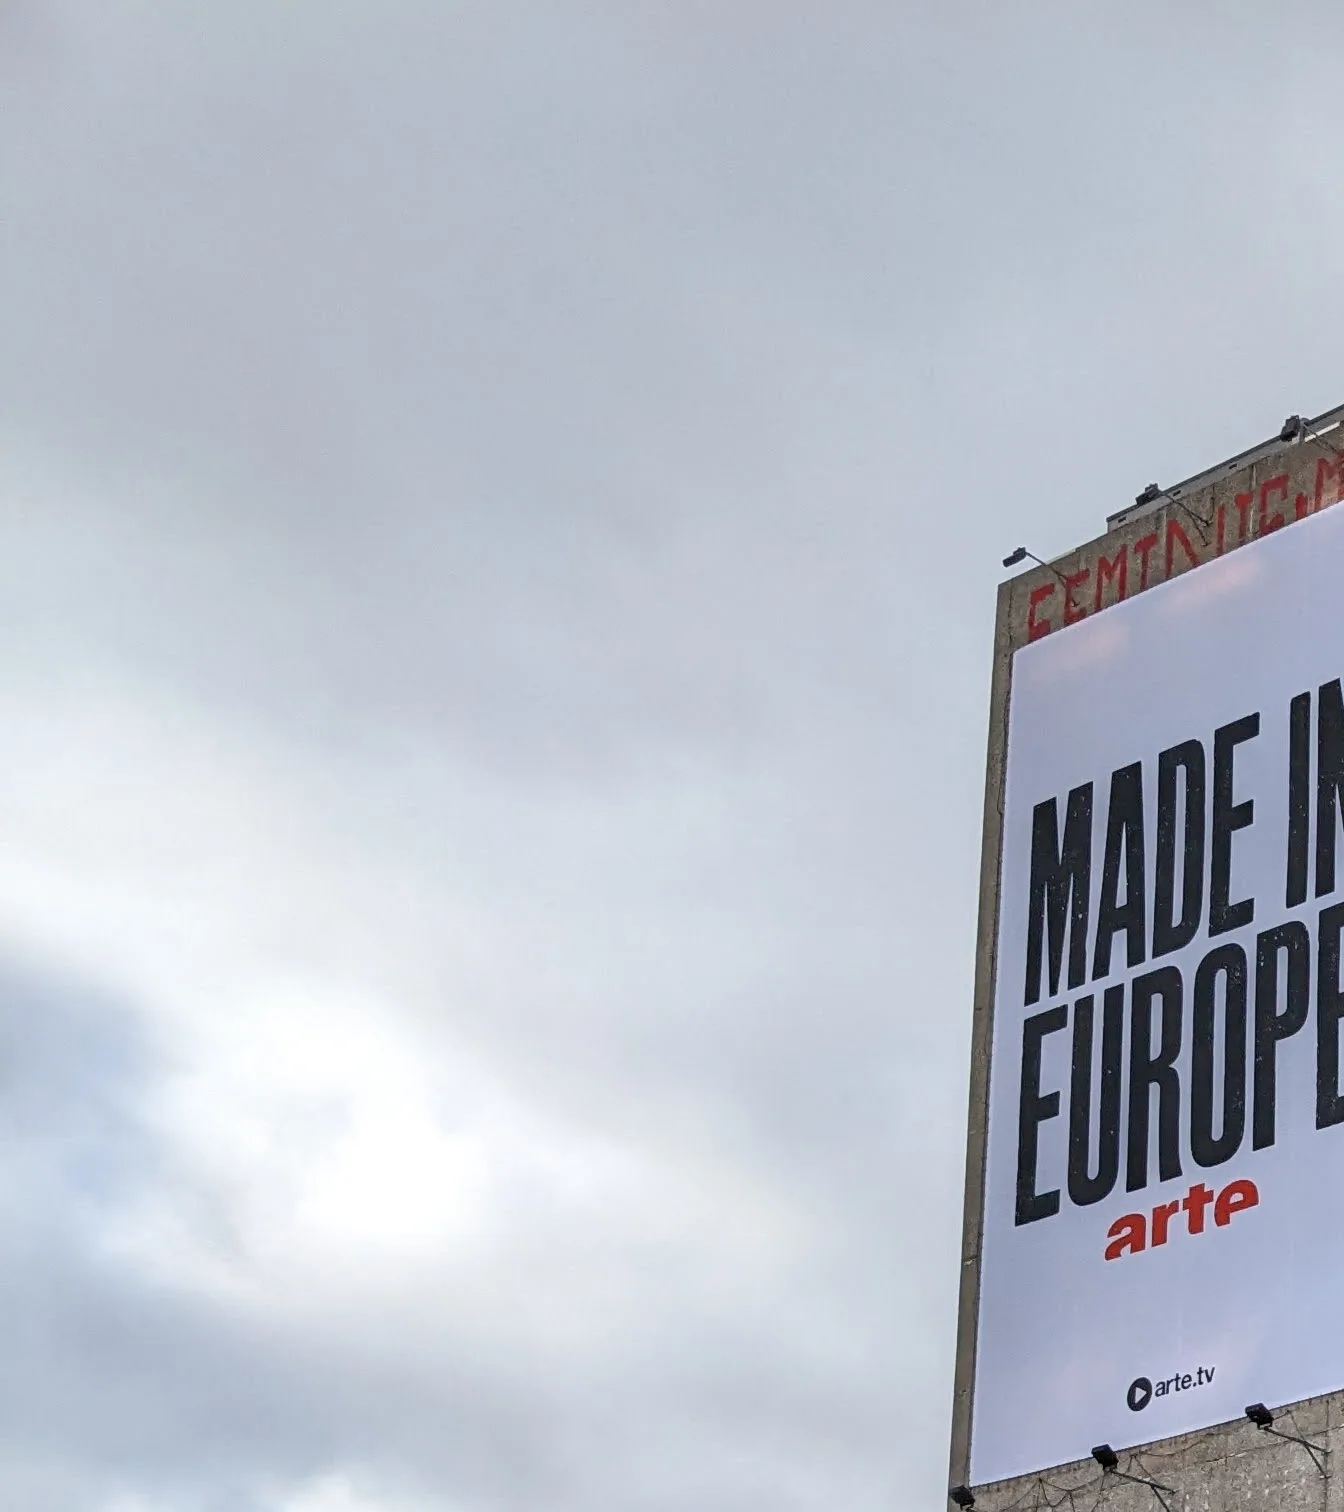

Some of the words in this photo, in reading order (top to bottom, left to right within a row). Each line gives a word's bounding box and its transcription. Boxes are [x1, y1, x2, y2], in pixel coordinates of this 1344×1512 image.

[1024, 711, 1260, 1007] MADE
[1104, 1179, 1260, 1262] arte
[1154, 1366, 1216, 1398] arte.tv
